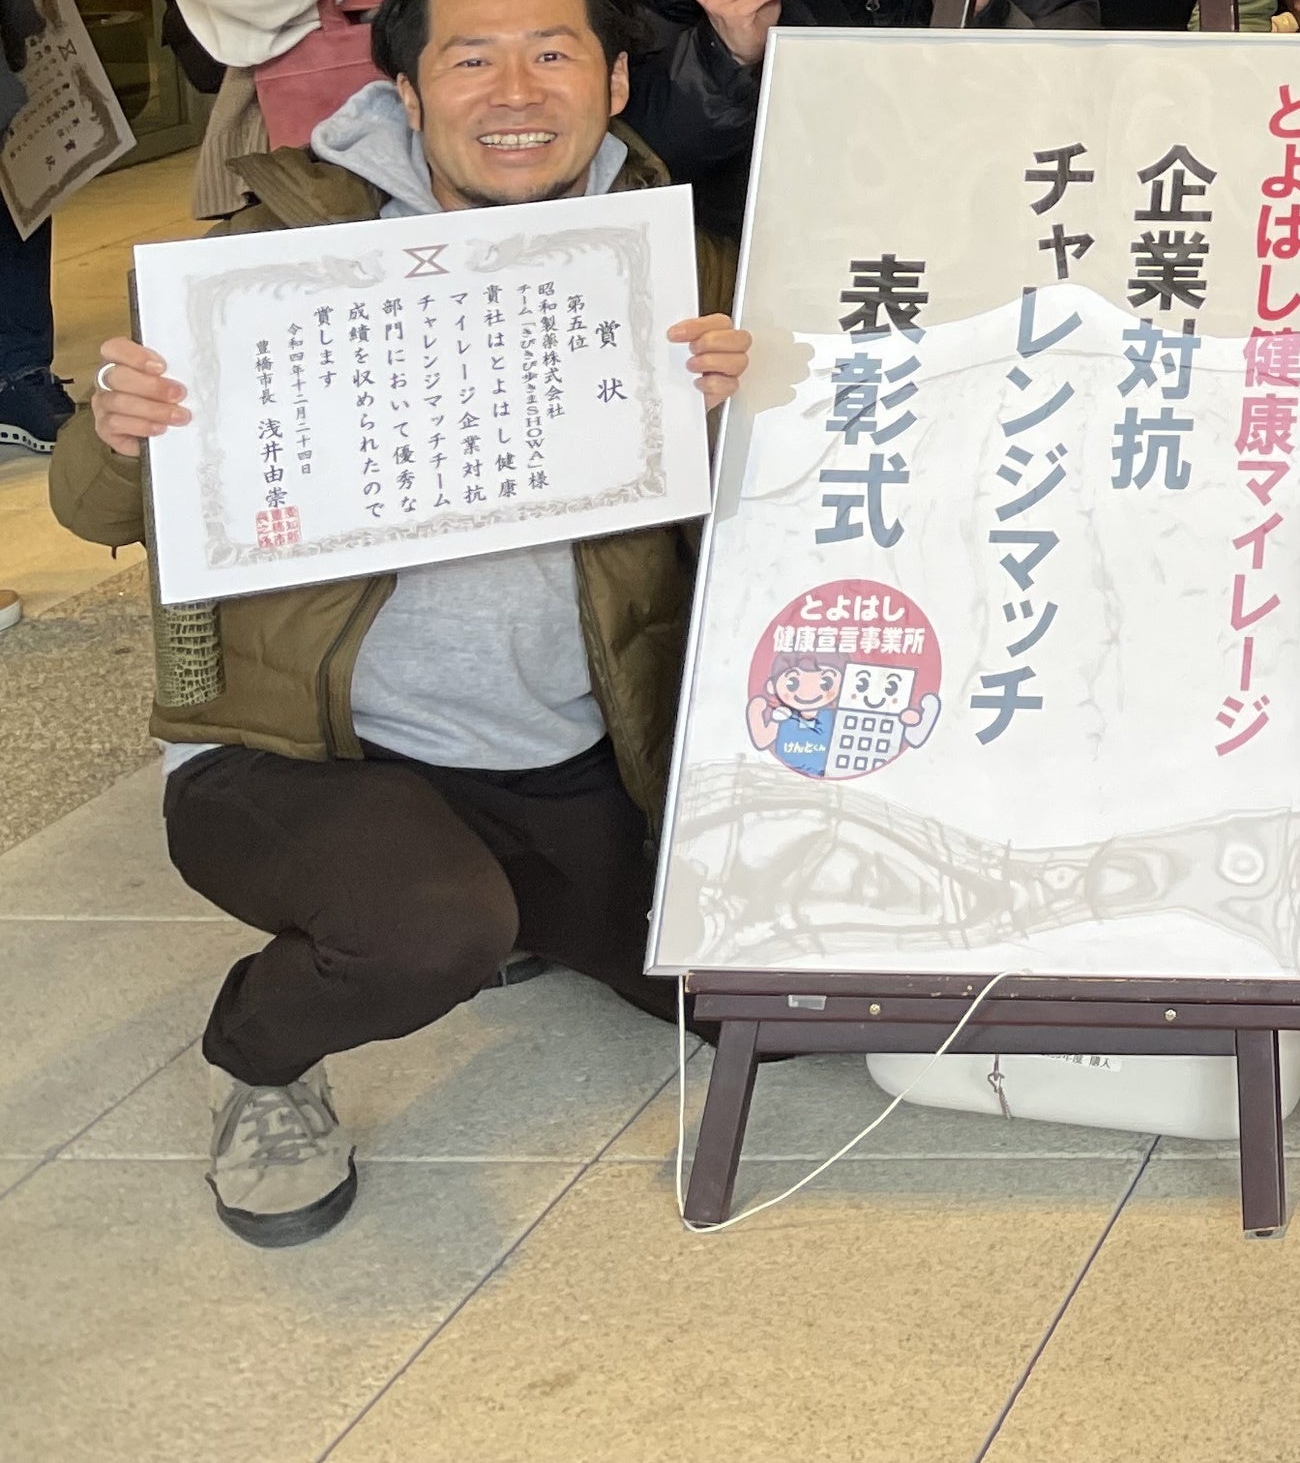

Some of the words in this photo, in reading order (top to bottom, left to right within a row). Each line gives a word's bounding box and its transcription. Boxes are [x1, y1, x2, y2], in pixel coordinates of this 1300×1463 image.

[255, 339, 277, 406] 豊橋市長
[314, 306, 335, 388] 賞します
[483, 284, 518, 498] 貴社はとよはし健康
[537, 281, 566, 419] 昭和製薬株式会社
[567, 295, 589, 353] 第五位
[595, 321, 629, 403] 賞状
[1111, 144, 1217, 491] 企業対抗
[258, 418, 288, 508] 浅井由崇
[287, 322, 312, 475] 令和四年十二月二十四日
[348, 302, 383, 518] 成績を収められたので
[382, 298, 418, 513] 部門において優秀な
[418, 295, 451, 508] チャレンジマッチチーム
[450, 292, 487, 504] マイレージ企業対抗
[814, 254, 930, 549] 表彰式
[969, 142, 1095, 746] チャレンジマッチ
[773, 625, 926, 654] 健康宣言事業所
[800, 594, 905, 622] とよはし
